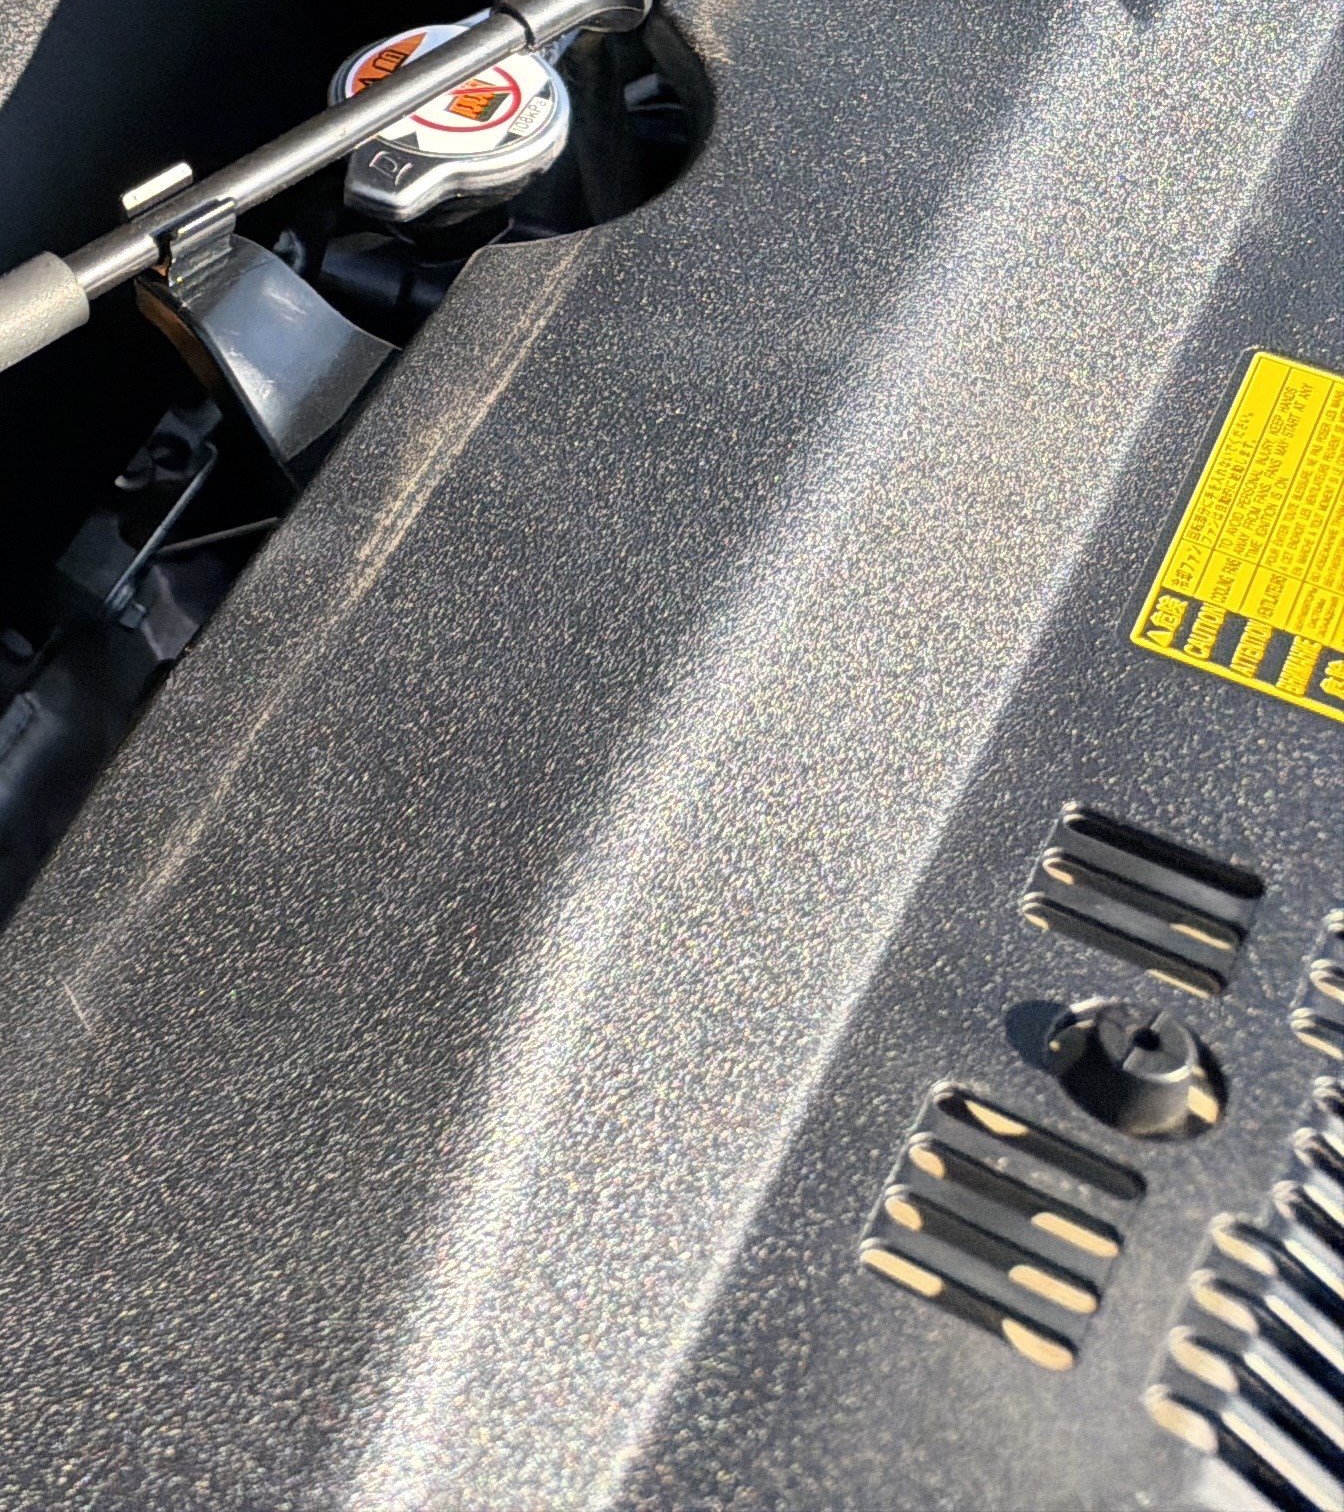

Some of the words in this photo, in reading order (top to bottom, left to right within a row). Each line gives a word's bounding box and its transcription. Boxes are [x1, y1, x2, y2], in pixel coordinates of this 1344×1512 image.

[511, 99, 548, 136] 108kPa
[1276, 386, 1297, 413] HANDS
[1297, 382, 1313, 399] ANY
[1291, 400, 1306, 412] AT
[1267, 413, 1284, 436] KEEP
[1280, 412, 1301, 438] START
[1272, 439, 1289, 457] MAY
[1263, 458, 1282, 479] FANS
[1236, 467, 1263, 509] PERSONAL
[1225, 511, 1244, 536] AVOID
[1241, 505, 1261, 530] FROM
[1244, 538, 1263, 559] TIME
[1254, 502, 1278, 537] IGNITION
[1269, 490, 1283, 501] IS
[1218, 537, 1233, 550] TO
[1232, 531, 1250, 554] AWAY
[1183, 600, 1228, 659] CAUTION
[1229, 618, 1274, 677] ATTENTION
